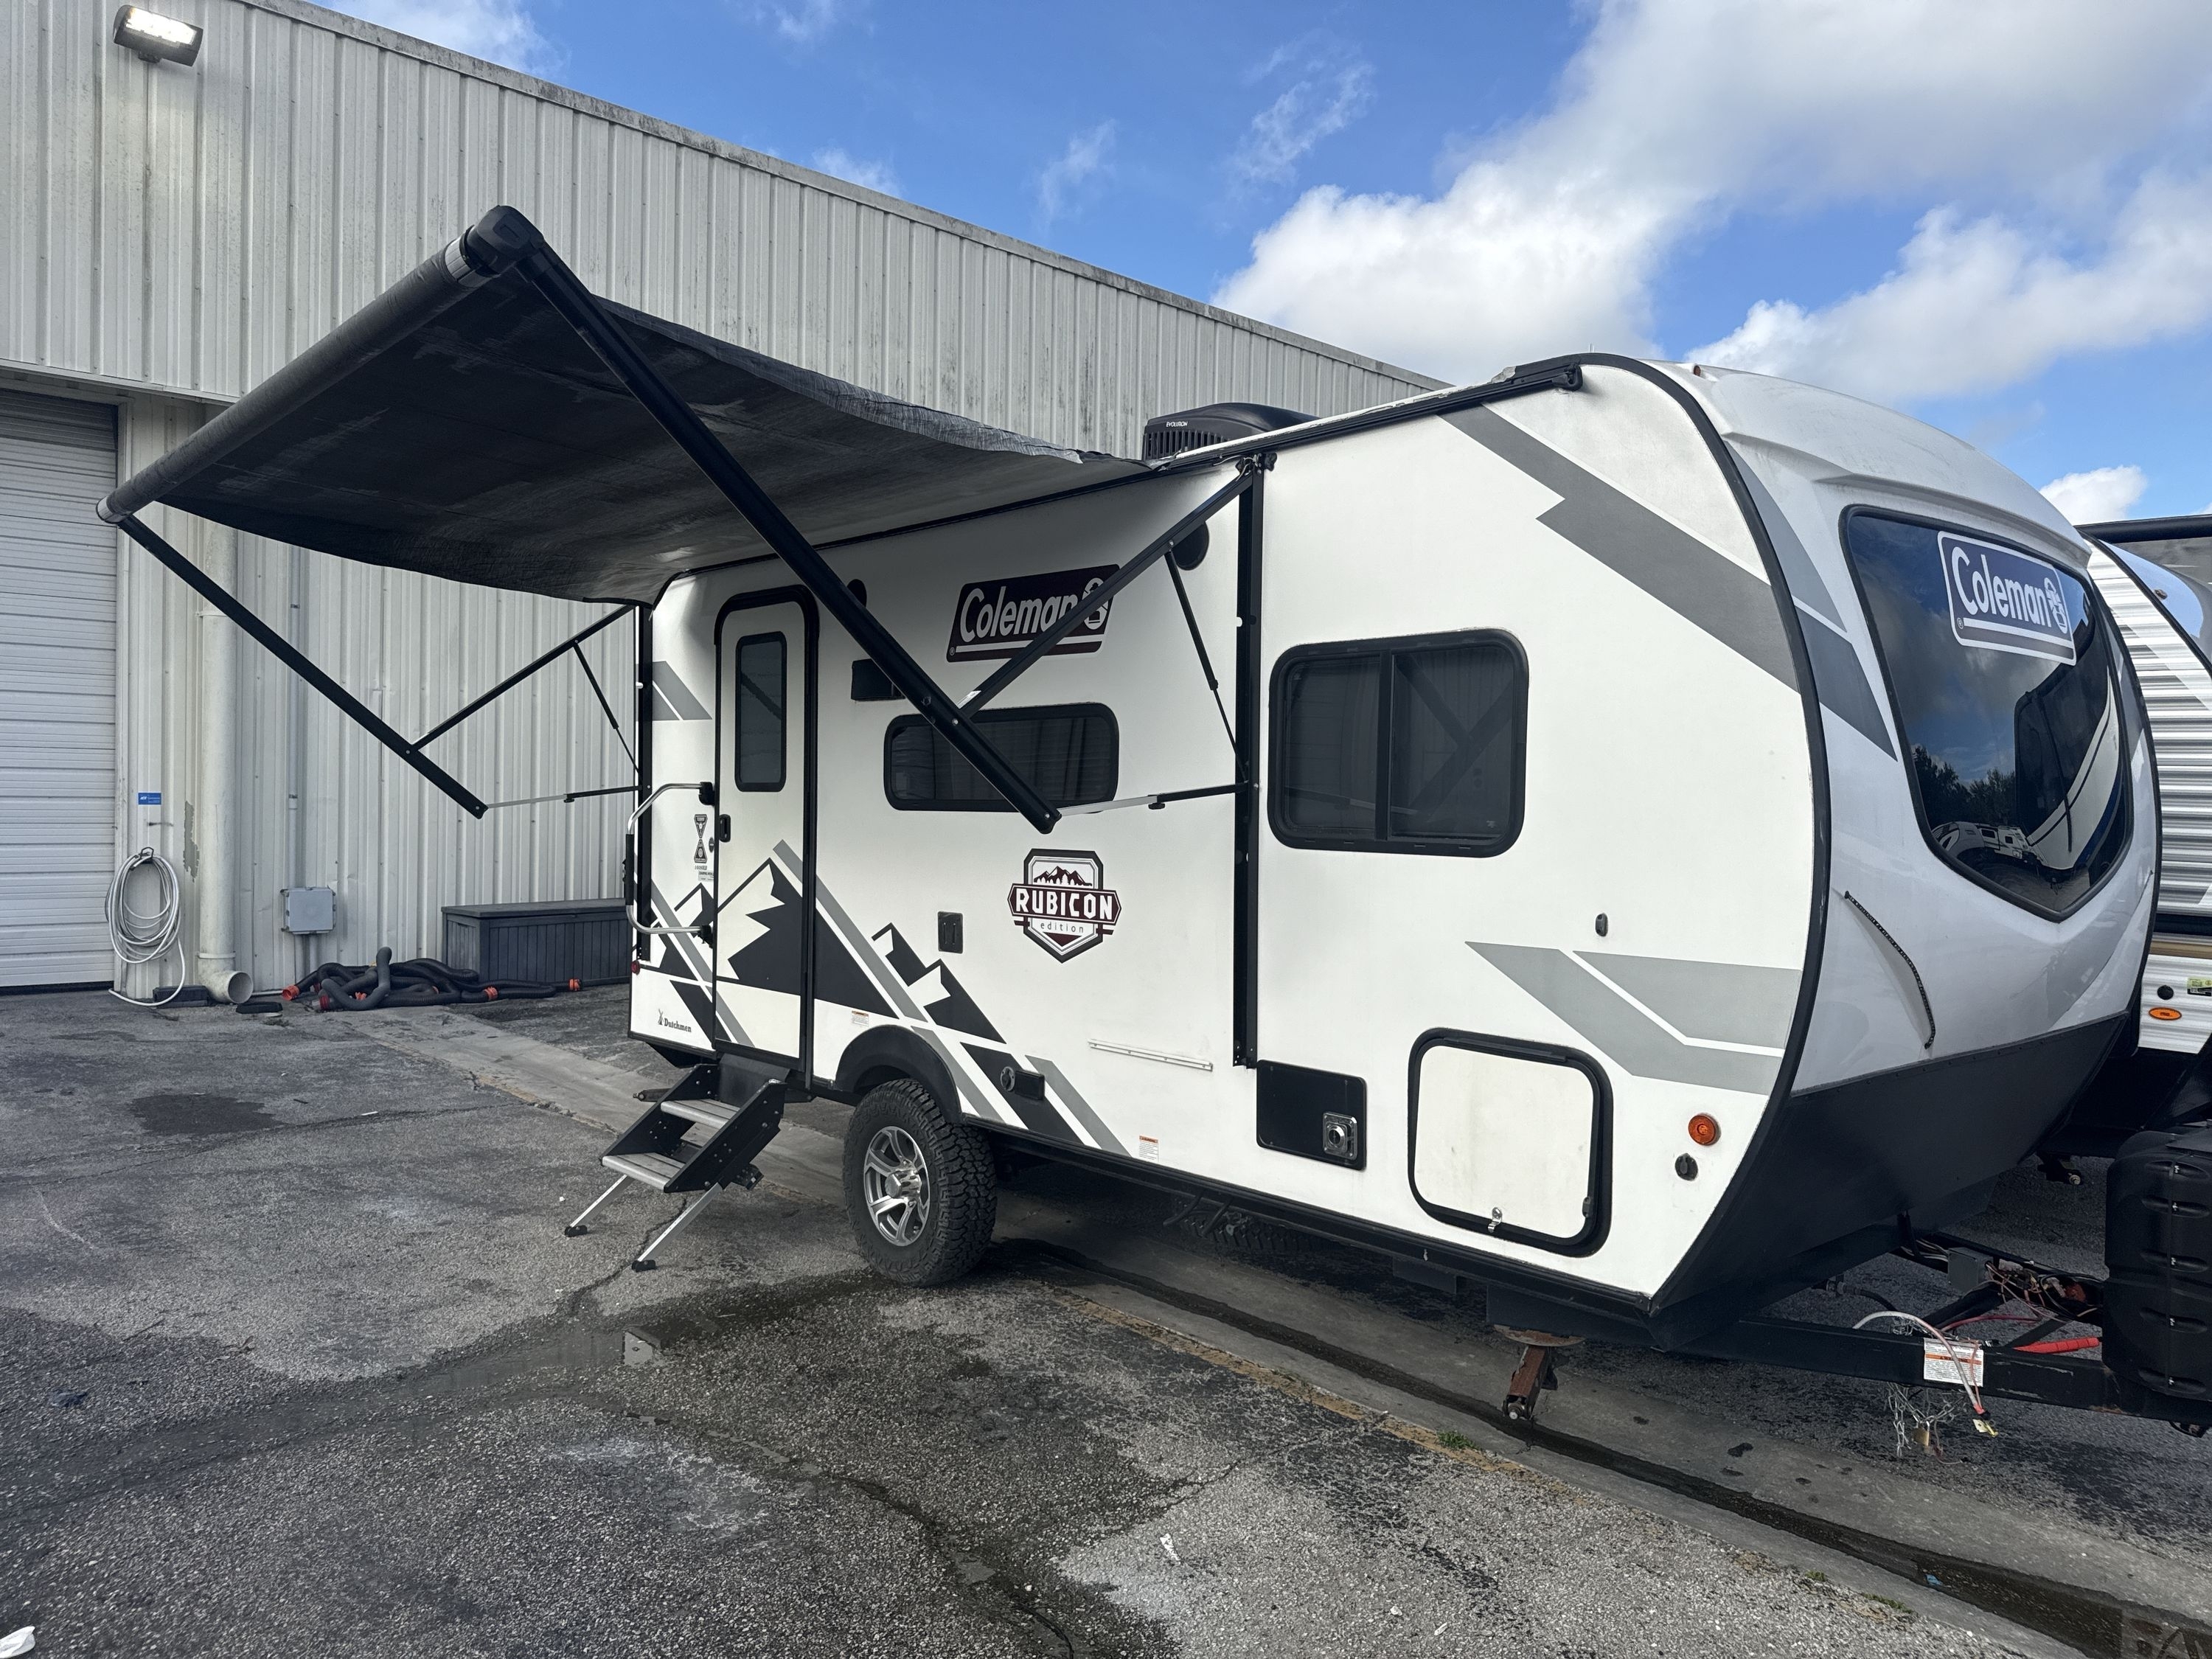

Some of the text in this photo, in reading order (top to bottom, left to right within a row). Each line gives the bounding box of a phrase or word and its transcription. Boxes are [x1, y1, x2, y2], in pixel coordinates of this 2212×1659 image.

[1952, 546, 2052, 627] Coleman
[1015, 888, 1112, 920] RUBICON
[1040, 922, 1084, 933] edition
[664, 1018, 692, 1032] Dutchmen
